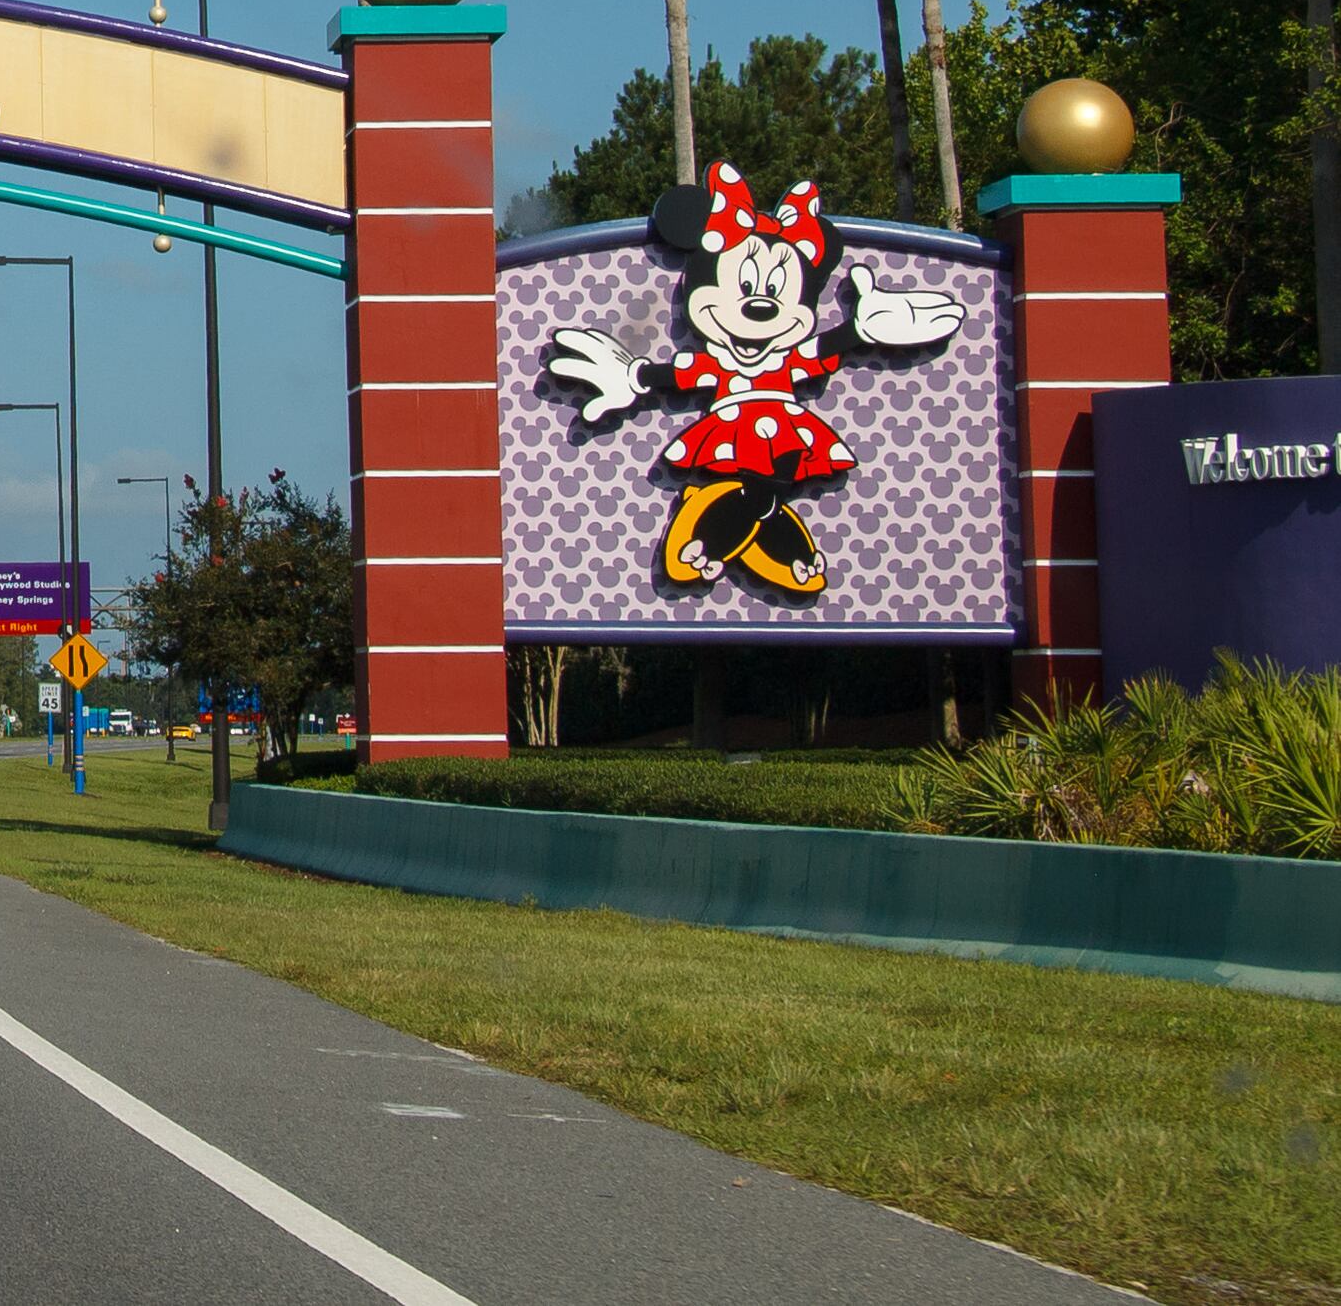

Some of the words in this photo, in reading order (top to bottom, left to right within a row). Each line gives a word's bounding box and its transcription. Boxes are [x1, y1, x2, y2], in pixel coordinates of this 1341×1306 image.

[1179, 433, 1331, 485] Welcome
[33, 581, 70, 589] Studis
[17, 595, 54, 605] Springs
[10, 623, 38, 633] Right
[41, 698, 58, 709] 45
